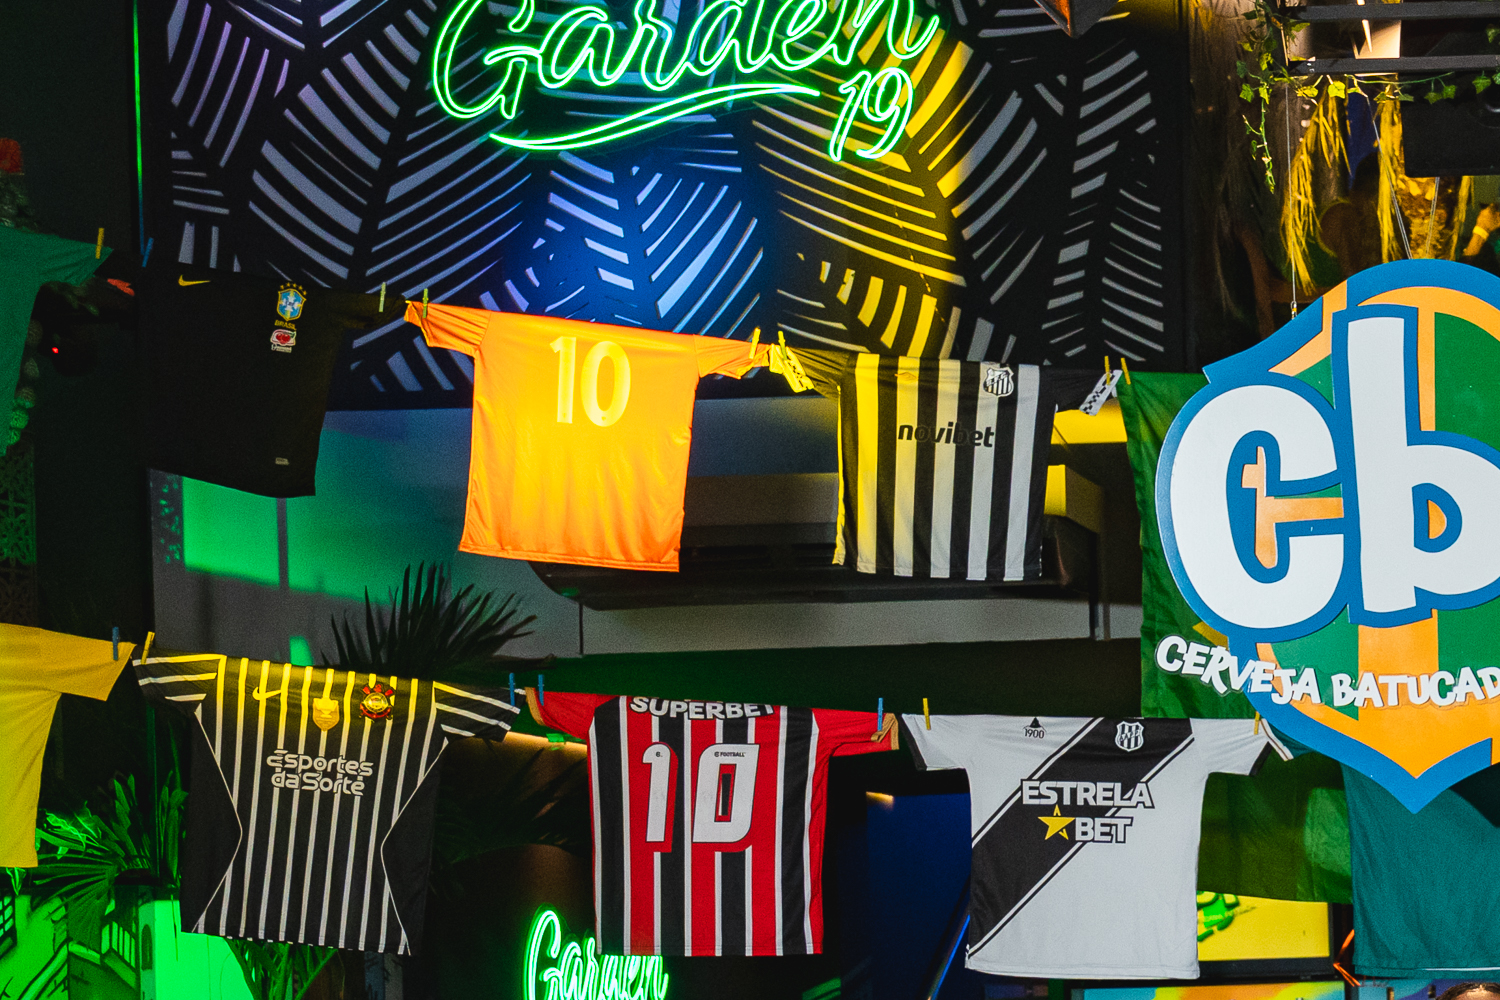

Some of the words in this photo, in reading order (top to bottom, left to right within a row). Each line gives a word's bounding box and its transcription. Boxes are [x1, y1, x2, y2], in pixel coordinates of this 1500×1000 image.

[829, 66, 914, 162] 19
[550, 336, 632, 427] 10
[898, 421, 995, 448] novibet
[1154, 633, 1322, 705] CERVEJA
[1024, 728, 1045, 739] 1900
[642, 742, 760, 844] 10
[1021, 779, 1156, 809] ESTRELA
[1074, 816, 1134, 844] BET
